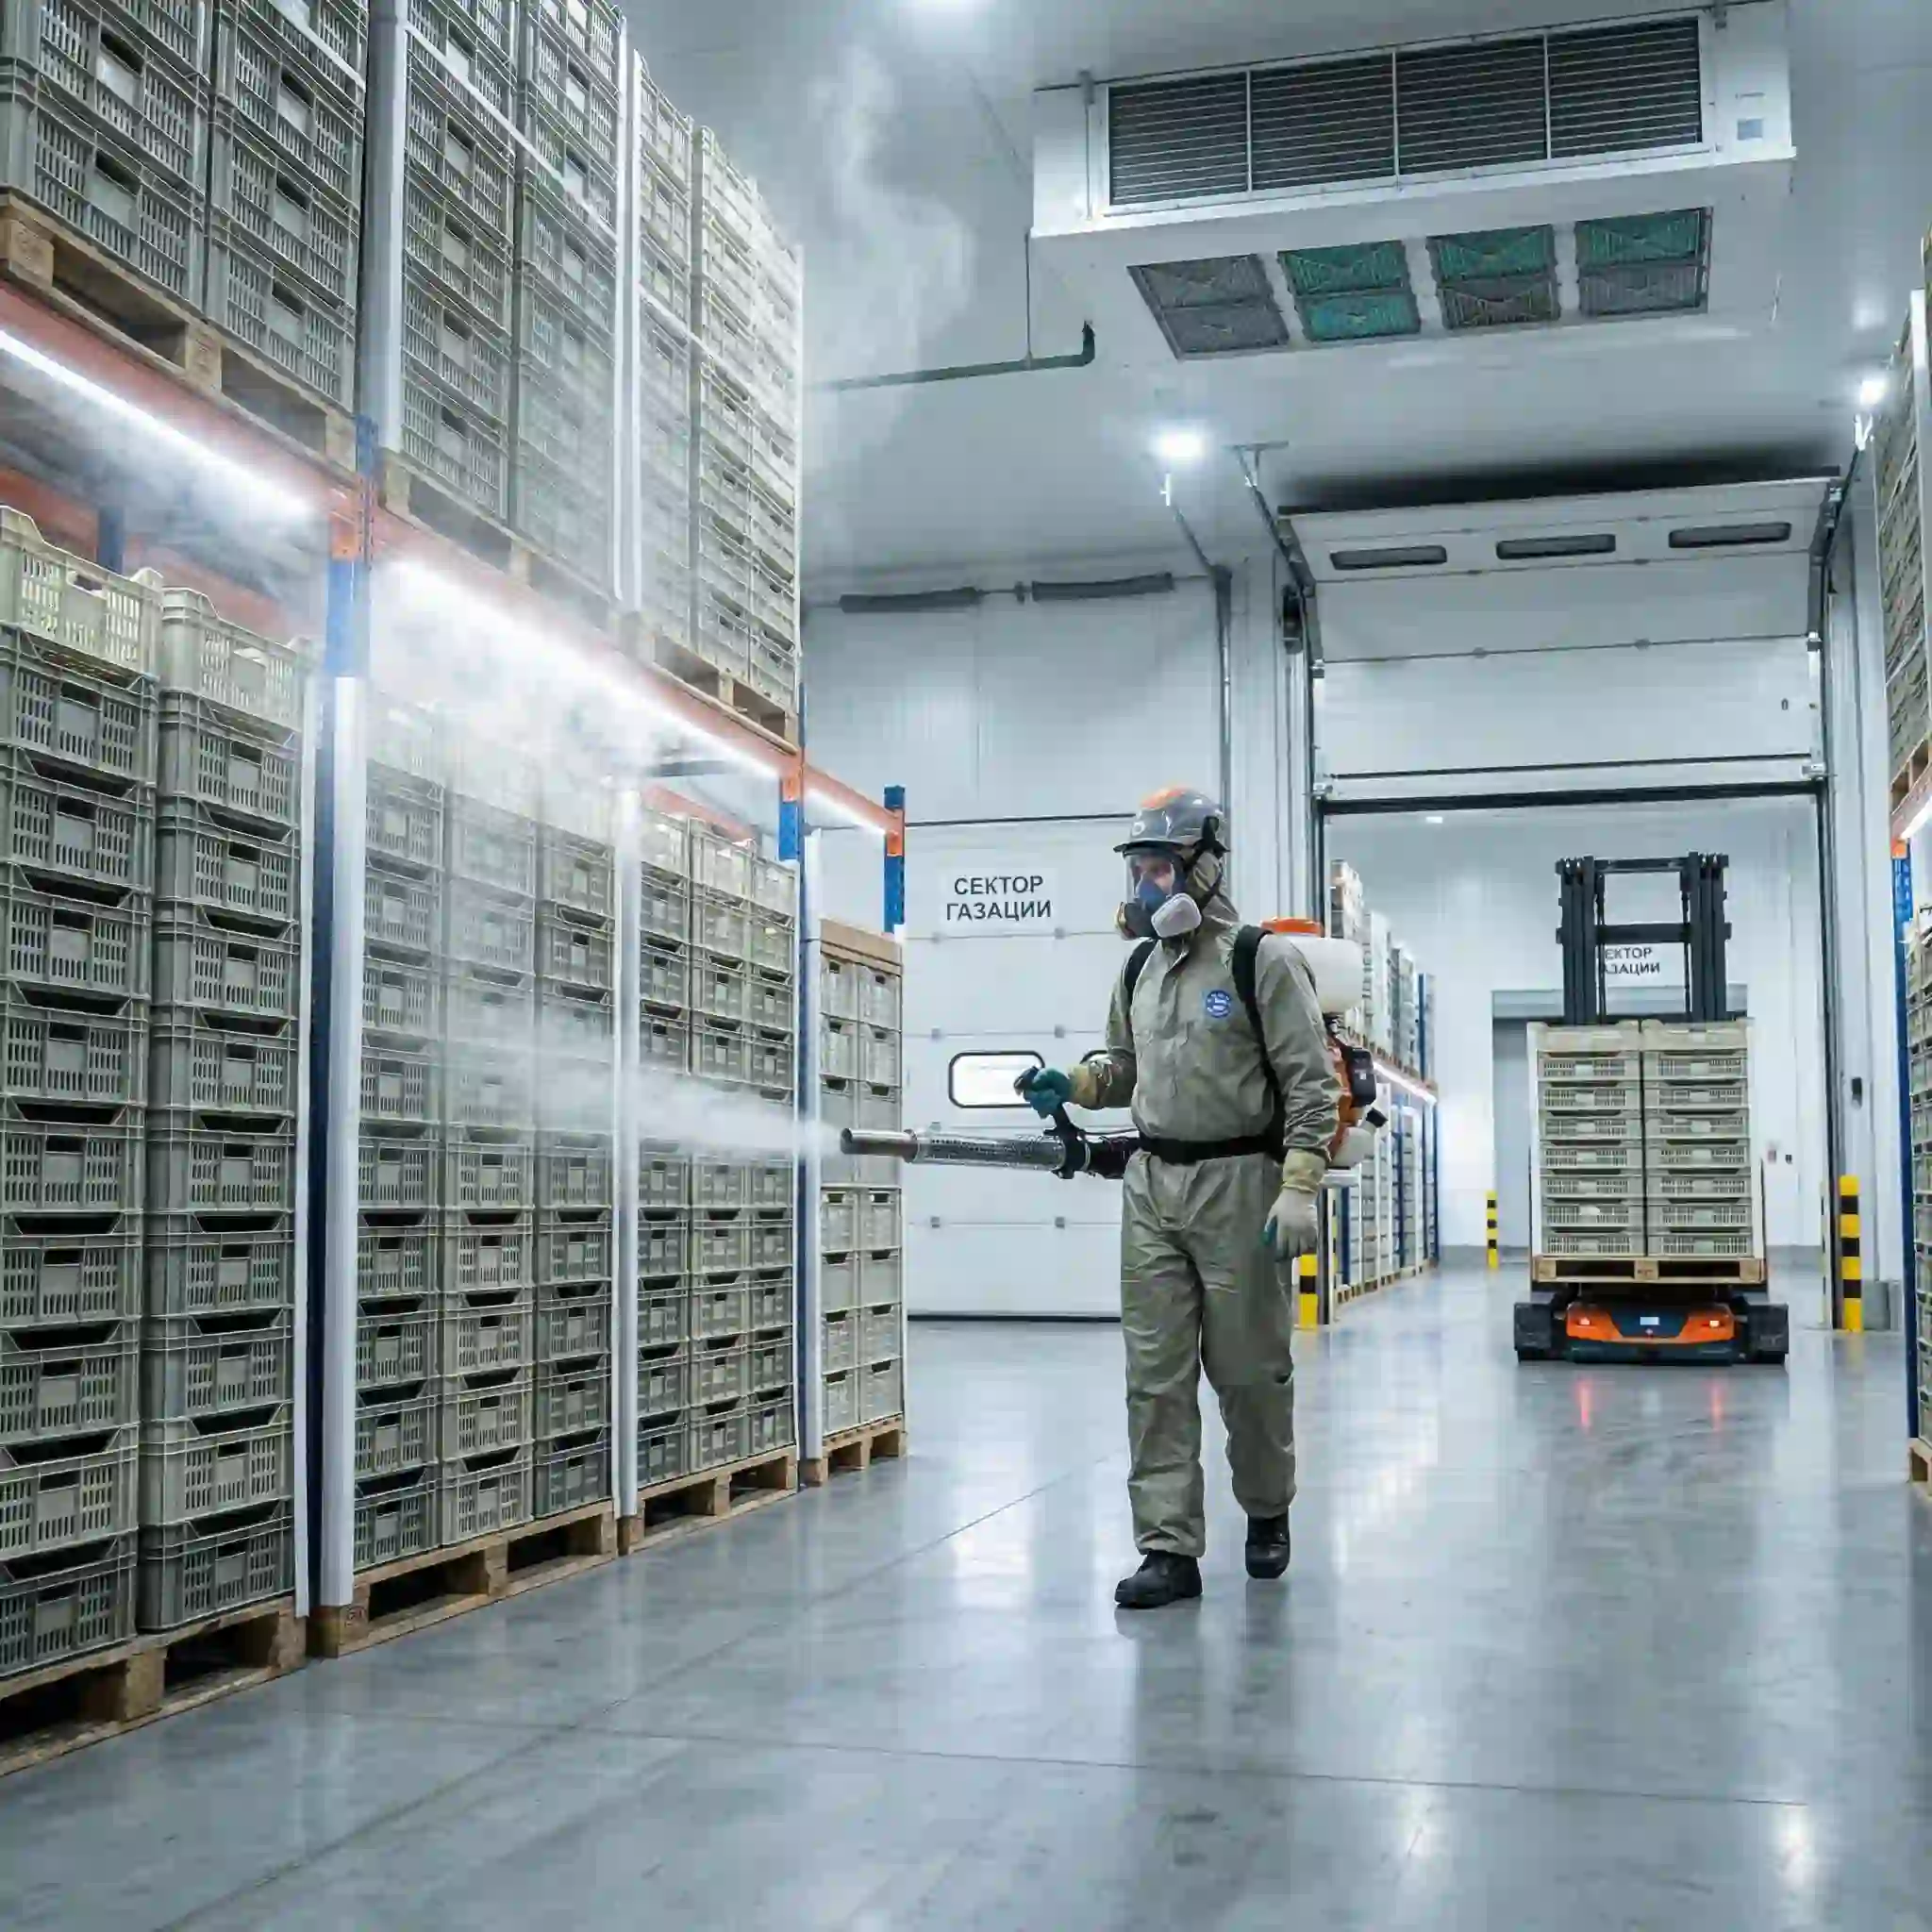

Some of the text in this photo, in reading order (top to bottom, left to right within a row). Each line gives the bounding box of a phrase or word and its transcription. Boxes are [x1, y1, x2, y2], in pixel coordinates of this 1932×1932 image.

[954, 875, 1043, 895] СЕКТОР
[946, 900, 1051, 922] ГАЗАЦИИ
[1605, 947, 1652, 959] ЕКТОР
